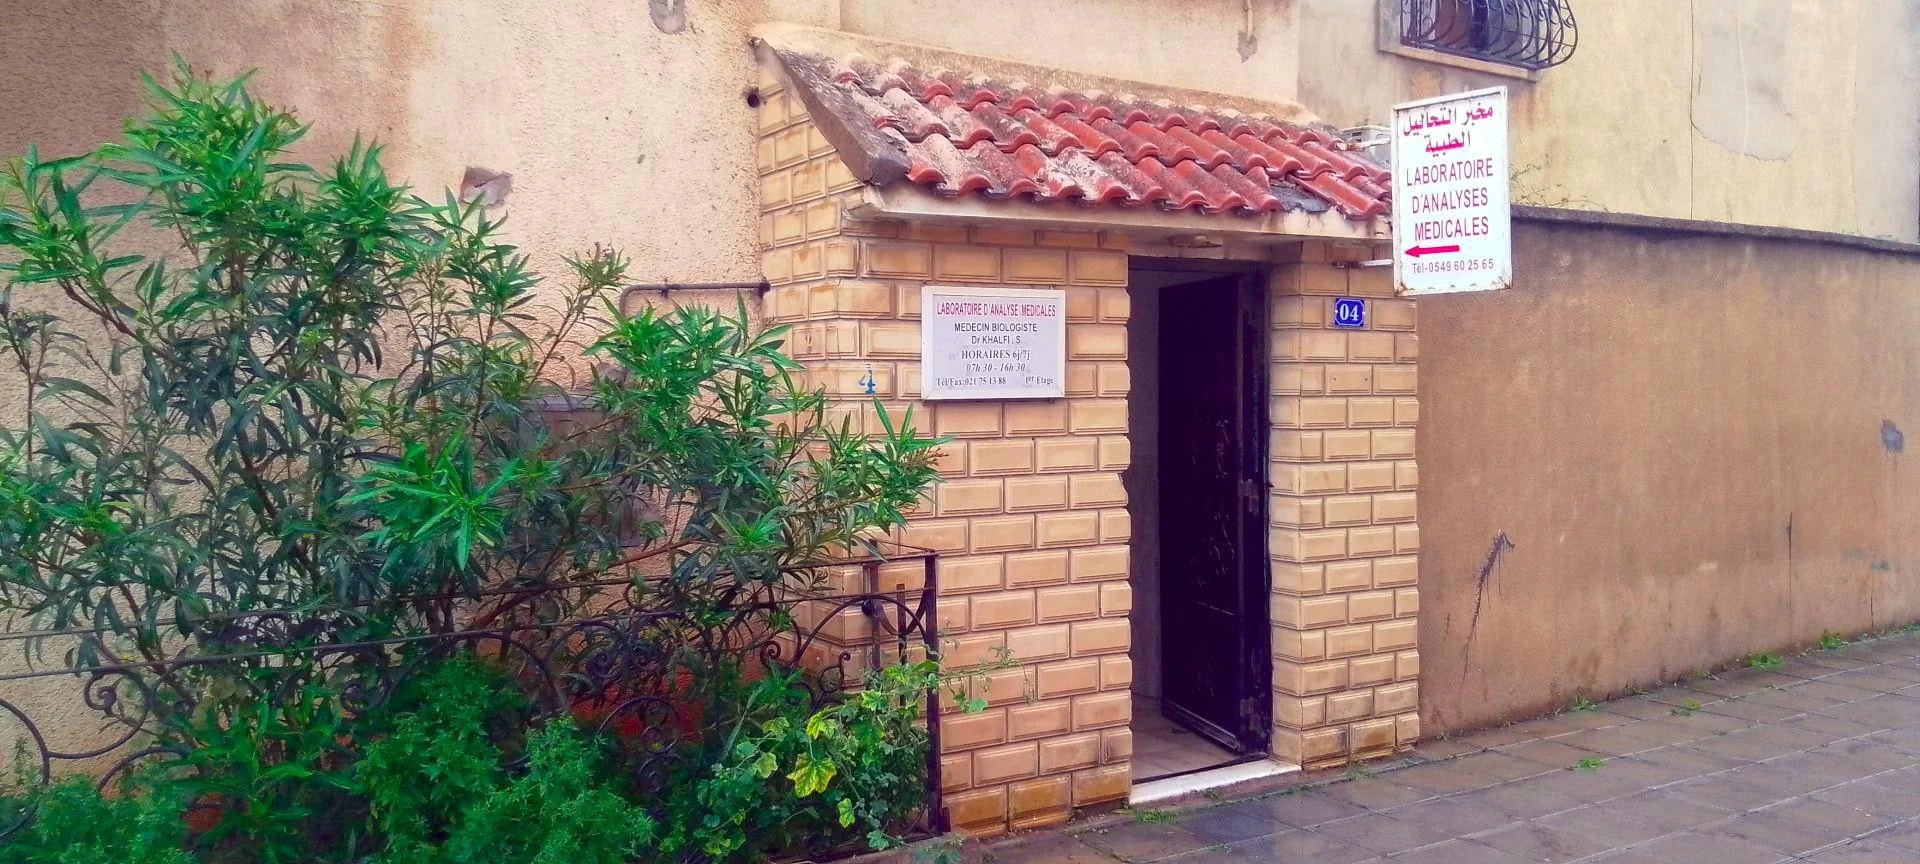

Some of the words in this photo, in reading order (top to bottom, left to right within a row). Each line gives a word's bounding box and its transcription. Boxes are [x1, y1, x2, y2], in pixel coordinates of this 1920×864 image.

[1403, 106, 1457, 137] التحاليل
[1461, 102, 1494, 126] مخبر
[1424, 130, 1471, 157] الطبية
[1406, 158, 1493, 187] LABORATOIRE
[1414, 215, 1489, 242] MEDICALES
[1454, 260, 1465, 271] 60
[1467, 259, 1479, 271] 25
[1481, 258, 1494, 270] 65
[937, 302, 982, 316] LABORATOIRE
[1021, 304, 1056, 317] MEDICALES
[1339, 303, 1360, 321] 04
[954, 322, 990, 332] MEDECIN
[991, 322, 1038, 332] BIOLOGISTE
[971, 335, 981, 344] Dr
[961, 350, 1011, 360] HORAIRES
[1012, 350, 1030, 361] 6j/7j
[966, 363, 981, 373] 07h
[983, 363, 993, 373] 30
[1000, 363, 1014, 372] 16h
[1015, 362, 1026, 372] 30
[978, 376, 988, 386] 75
[989, 376, 997, 385] 13
[998, 376, 1007, 385] 88
